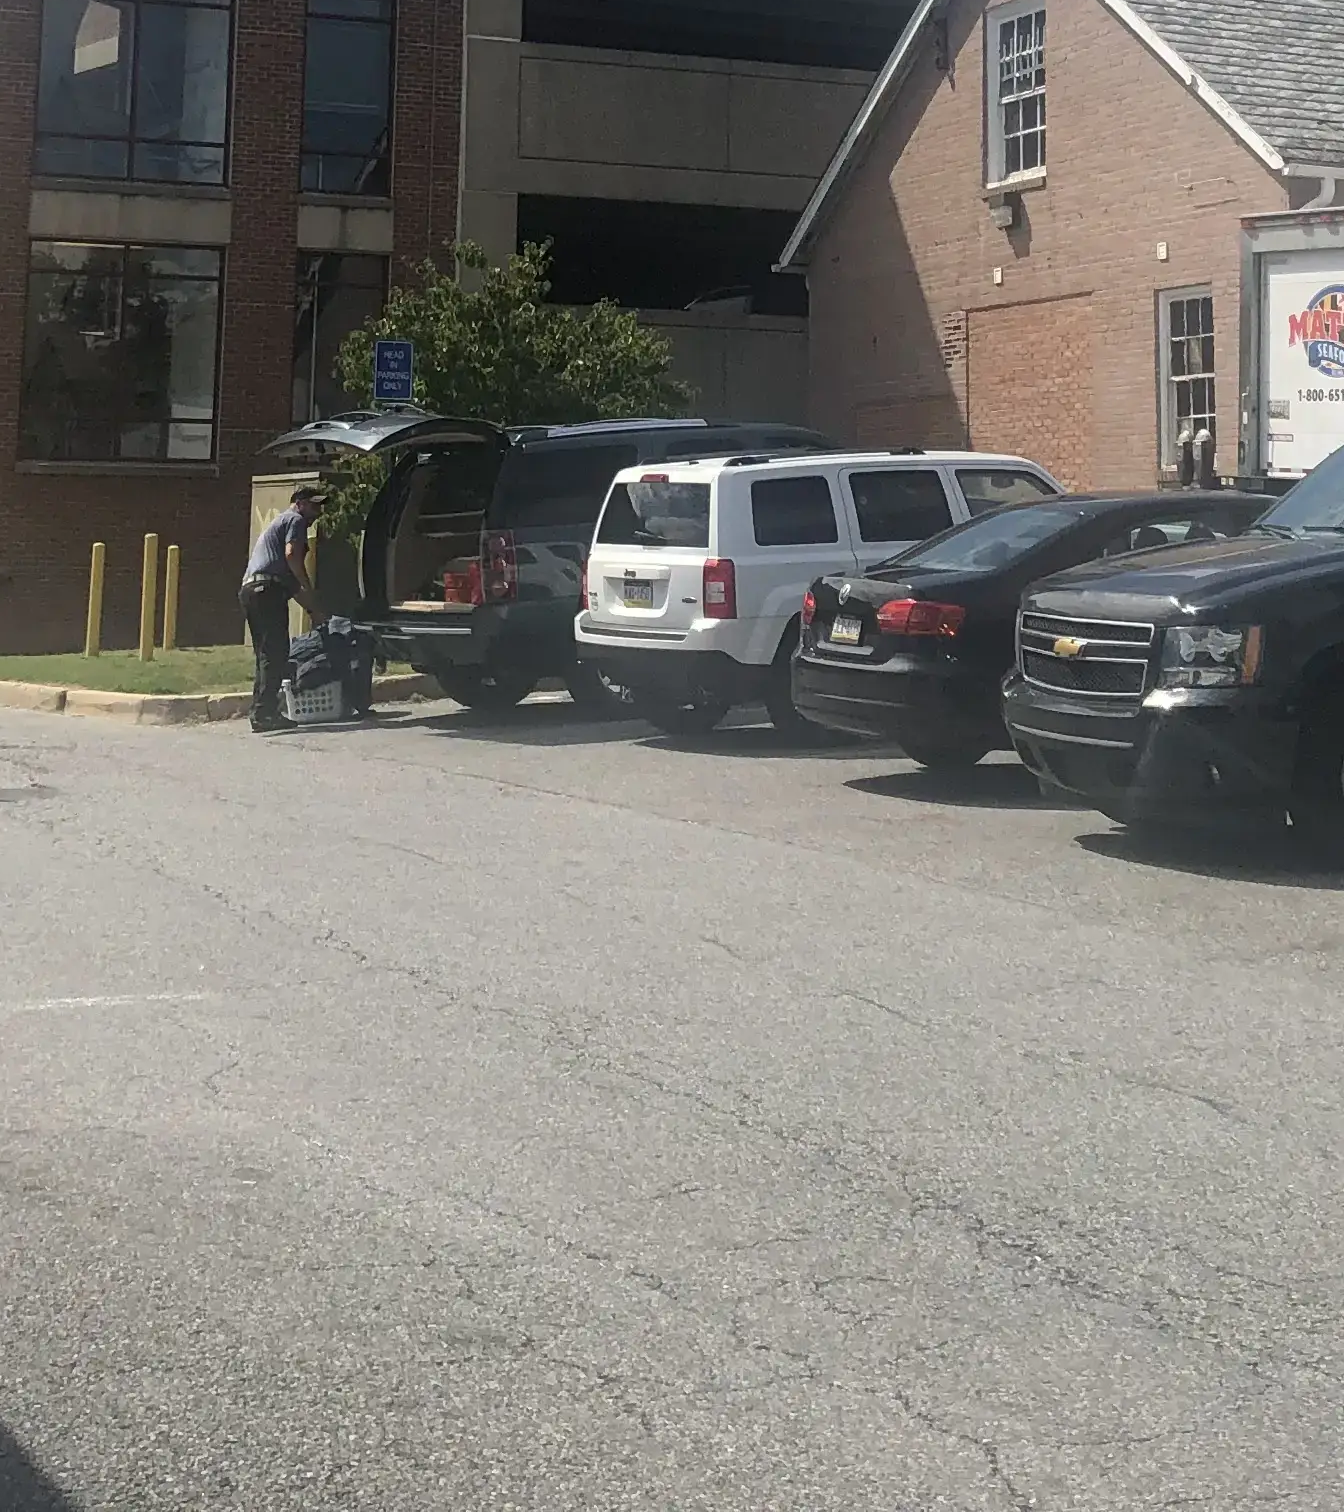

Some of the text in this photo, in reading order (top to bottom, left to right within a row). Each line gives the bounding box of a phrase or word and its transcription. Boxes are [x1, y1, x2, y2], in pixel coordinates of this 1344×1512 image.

[383, 350, 405, 360] HEAD
[377, 370, 411, 380] PARKING
[382, 381, 402, 391] ONLY
